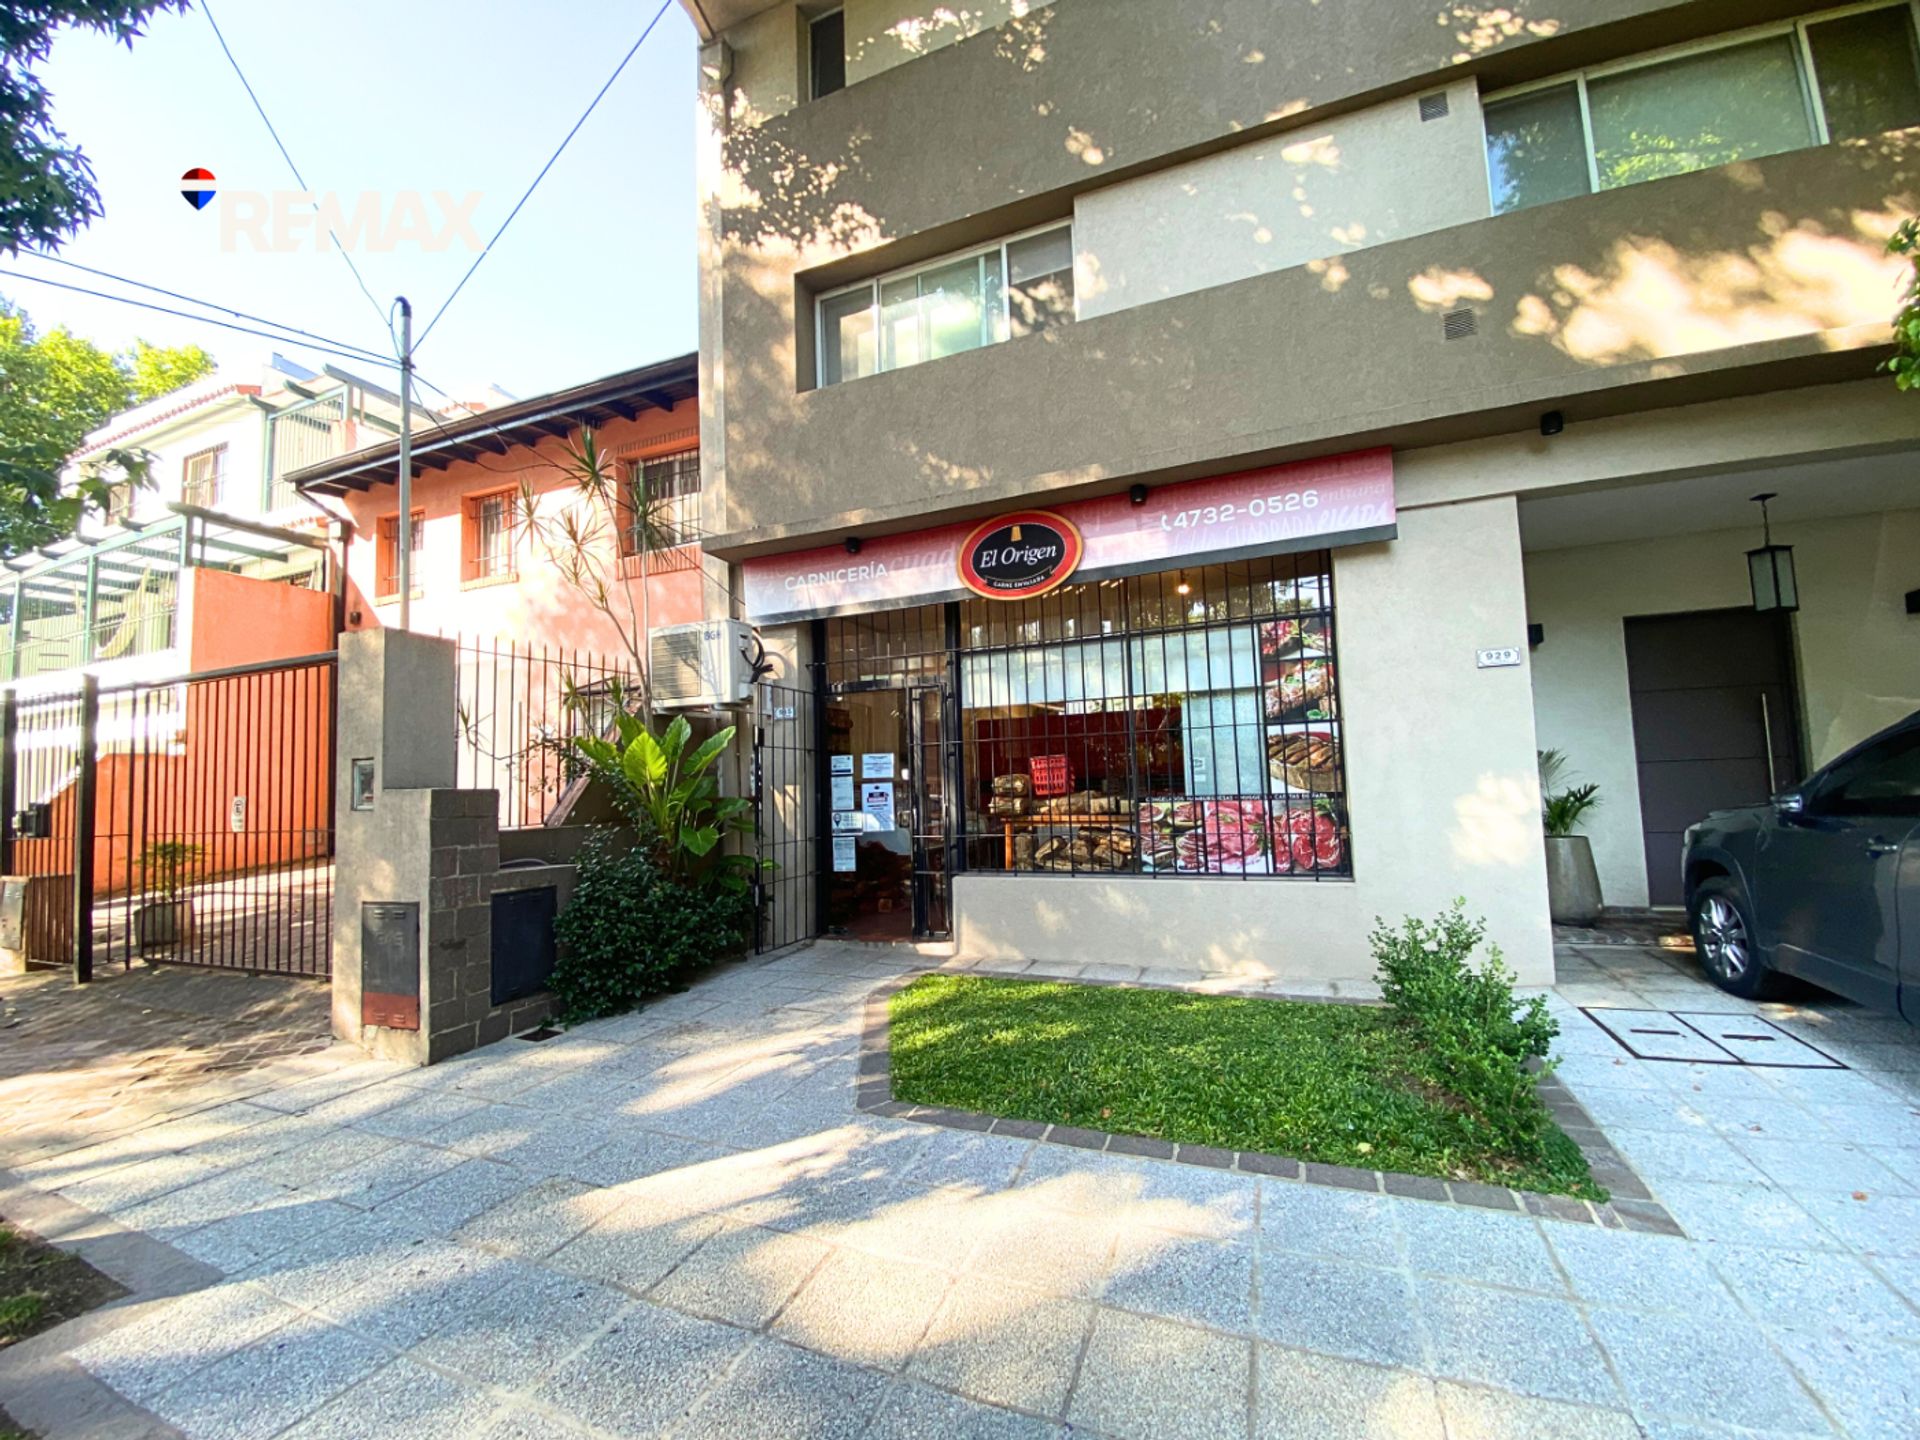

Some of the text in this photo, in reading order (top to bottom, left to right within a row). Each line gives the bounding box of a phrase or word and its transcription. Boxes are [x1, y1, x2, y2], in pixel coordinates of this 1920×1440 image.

[1174, 490, 1319, 529] 4732-0526
[979, 545, 1057, 568] El Origen
[784, 561, 888, 591] CARNICERÍA
[1485, 650, 1511, 660] 929
